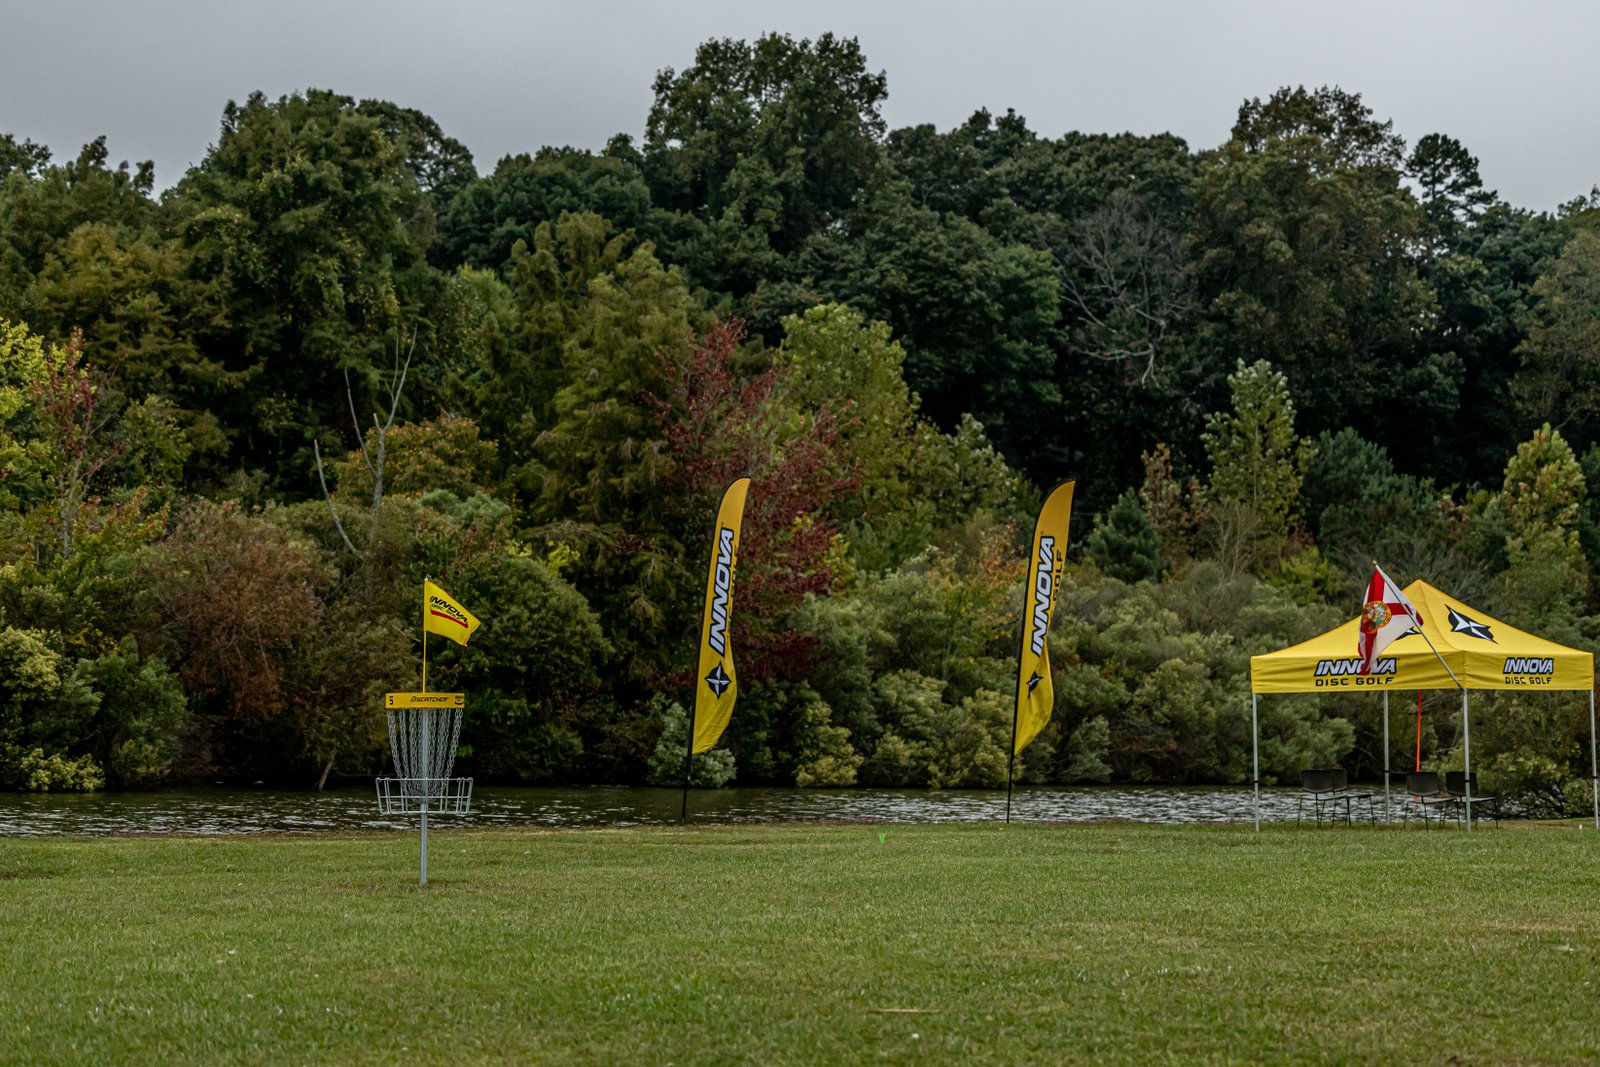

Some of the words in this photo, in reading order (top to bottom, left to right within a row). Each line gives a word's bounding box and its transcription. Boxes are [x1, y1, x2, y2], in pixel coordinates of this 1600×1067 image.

[709, 527, 734, 657] INNOVA
[1031, 536, 1055, 657] INNOVA
[430, 596, 468, 623] INNOVA
[1503, 657, 1554, 675] INNOVA
[1315, 678, 1349, 687] DISC
[1355, 677, 1395, 686] GOLF
[1505, 676, 1527, 685] DISC
[1529, 676, 1552, 685] GOLF
[389, 695, 394, 705] 5
